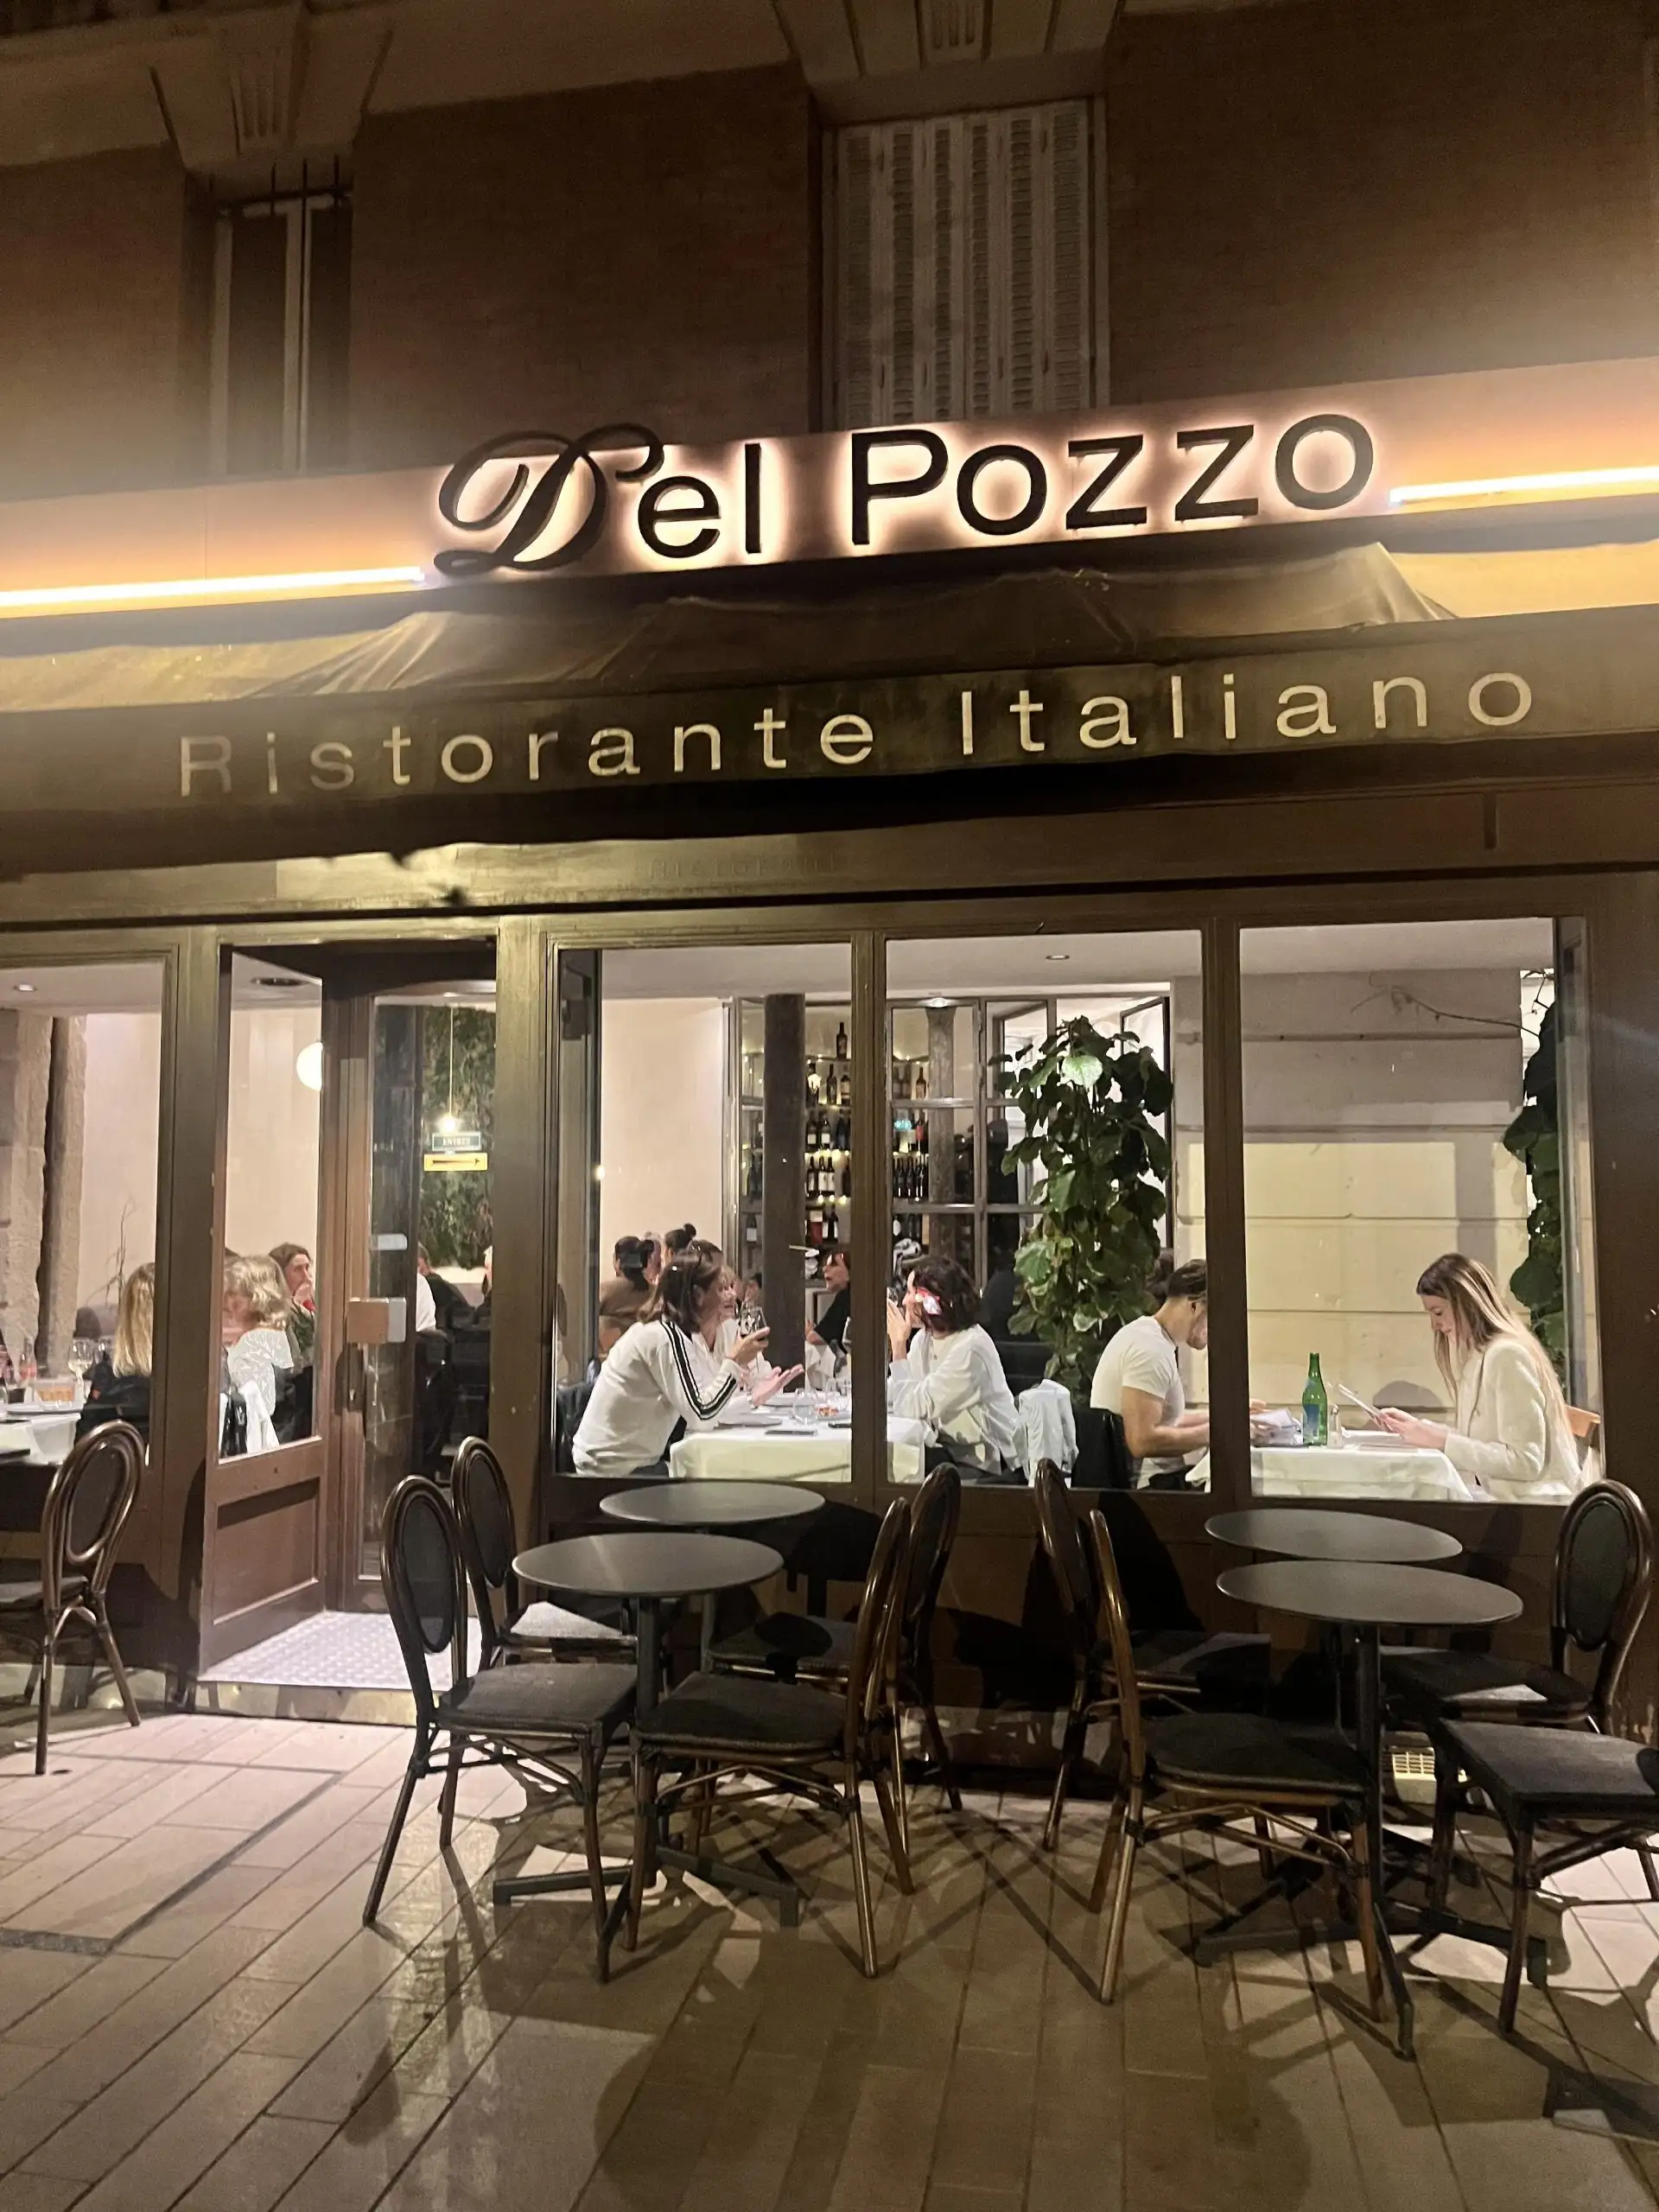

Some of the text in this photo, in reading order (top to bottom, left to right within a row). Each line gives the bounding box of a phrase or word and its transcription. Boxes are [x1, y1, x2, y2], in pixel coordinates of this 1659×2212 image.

[434, 424, 762, 573] Del
[180, 673, 1532, 797] Ristorante Italiano
